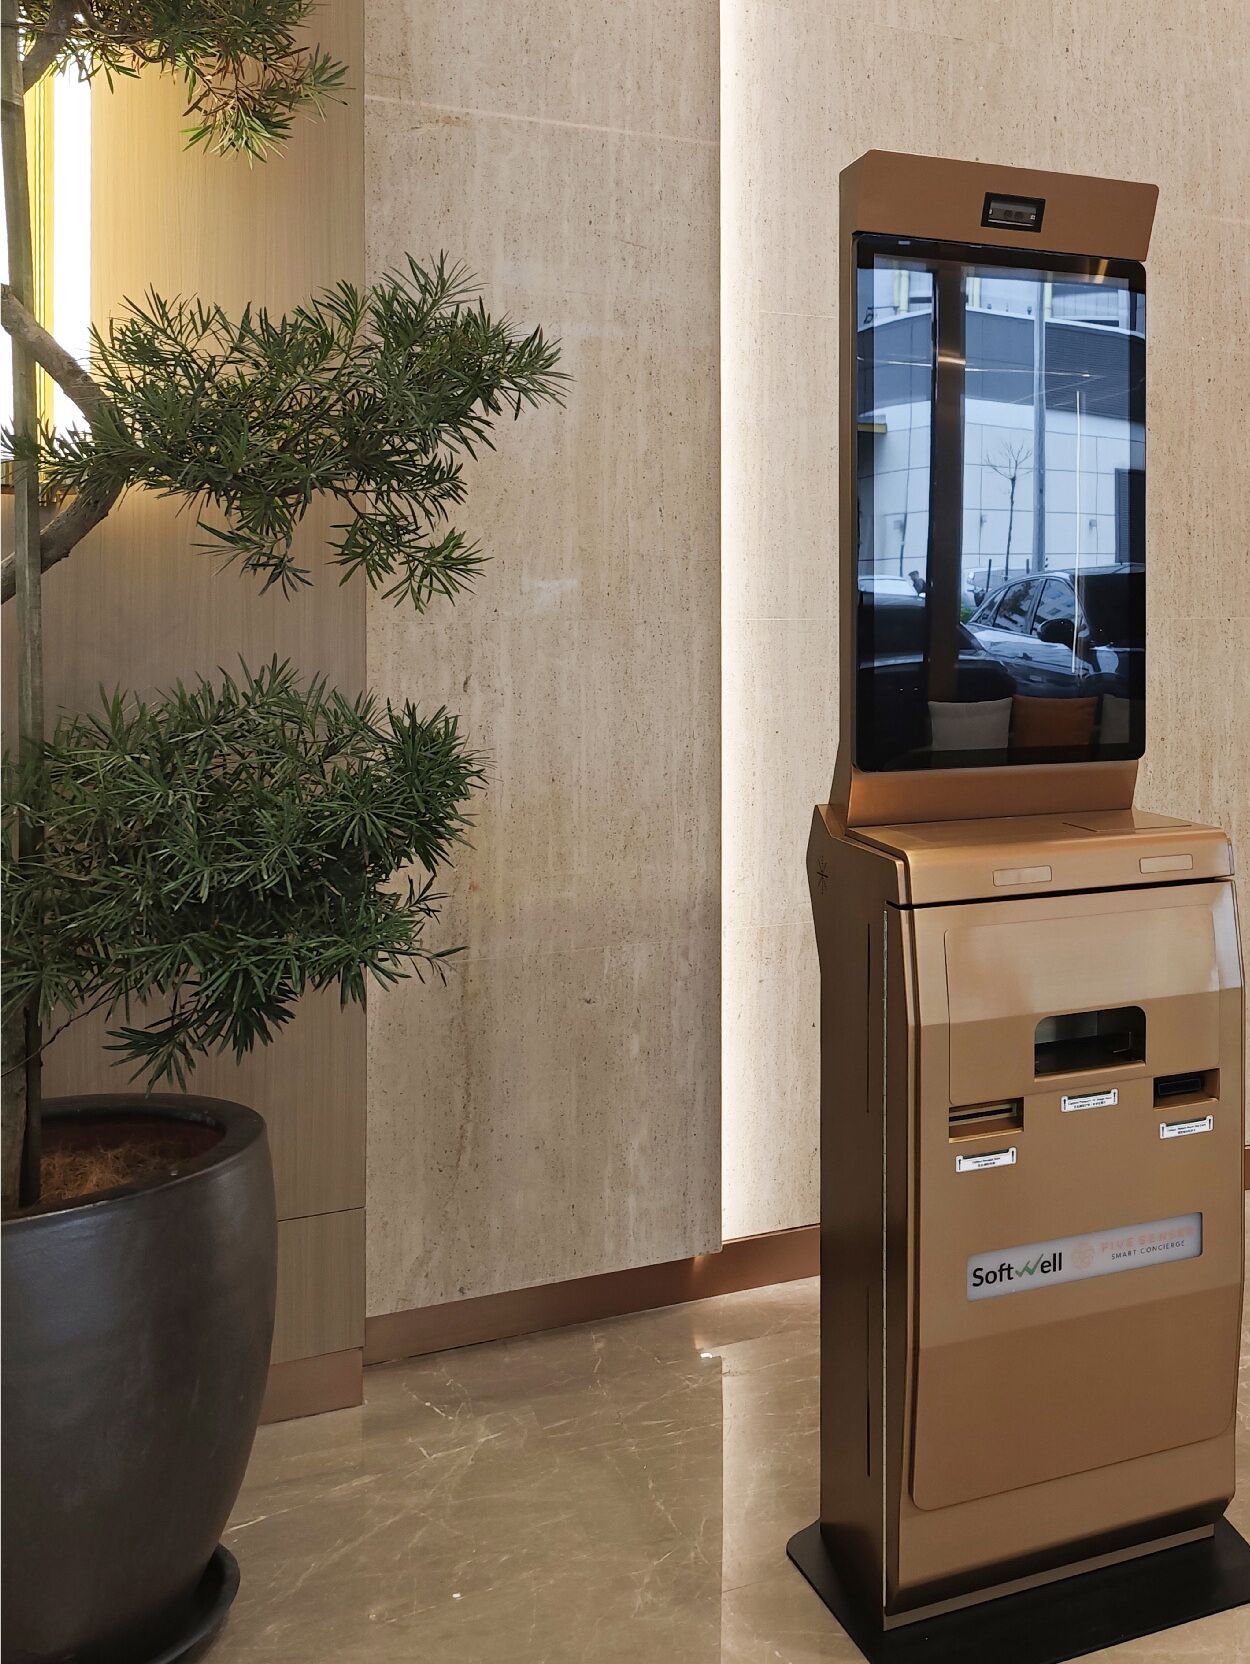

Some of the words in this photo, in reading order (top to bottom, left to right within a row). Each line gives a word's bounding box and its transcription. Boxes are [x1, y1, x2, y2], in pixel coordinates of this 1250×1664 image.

[1100, 1236, 1133, 1252] FIVE
[1111, 1249, 1137, 1260] SMART
[1140, 1239, 1185, 1255] CONCIERGE
